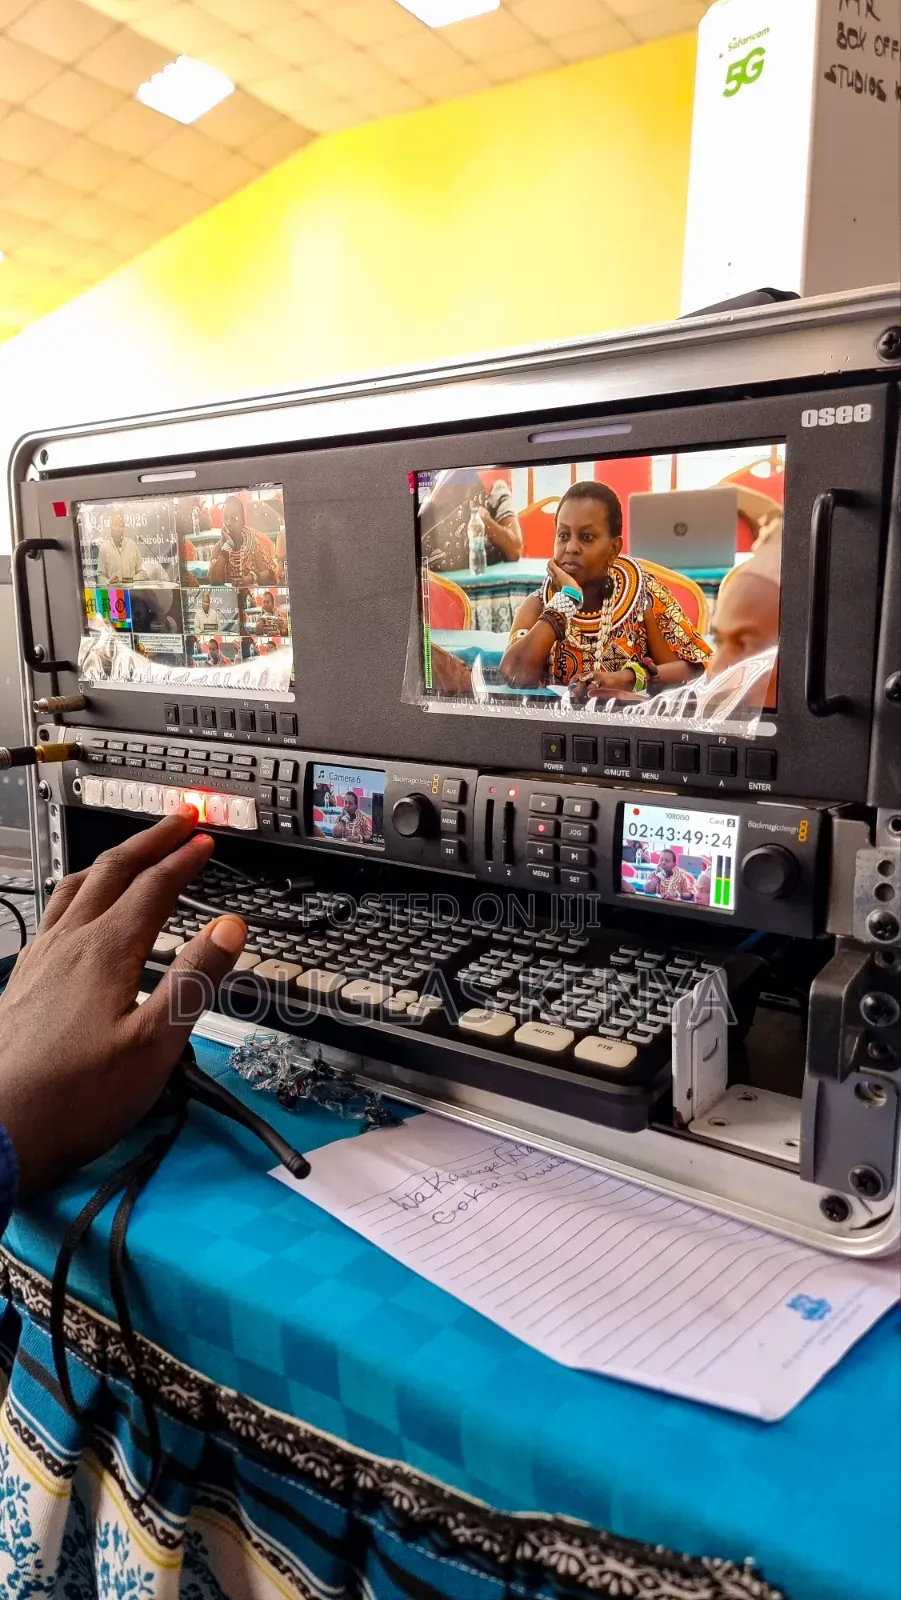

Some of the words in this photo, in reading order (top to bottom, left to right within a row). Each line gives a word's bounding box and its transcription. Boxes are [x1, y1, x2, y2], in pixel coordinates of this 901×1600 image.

[728, 27, 770, 51] Safaricom
[723, 46, 766, 98] 5G
[801, 403, 872, 428] osee
[124, 513, 148, 529] 2026
[681, 733, 689, 741] F1
[718, 736, 727, 744] F2
[543, 762, 564, 771] POWER
[582, 765, 588, 773] IN
[328, 771, 355, 783] Camera
[356, 775, 361, 783] 6
[641, 772, 659, 780] MENU
[748, 782, 771, 791] ENTER
[442, 817, 457, 825] MENU
[709, 817, 725, 826] Card
[747, 819, 798, 833] Blackmagicdesign
[569, 828, 582, 836] JOG
[628, 821, 733, 849] 02:43:49:24
[532, 869, 550, 878] MENU
[533, 1028, 555, 1036] AUTO
